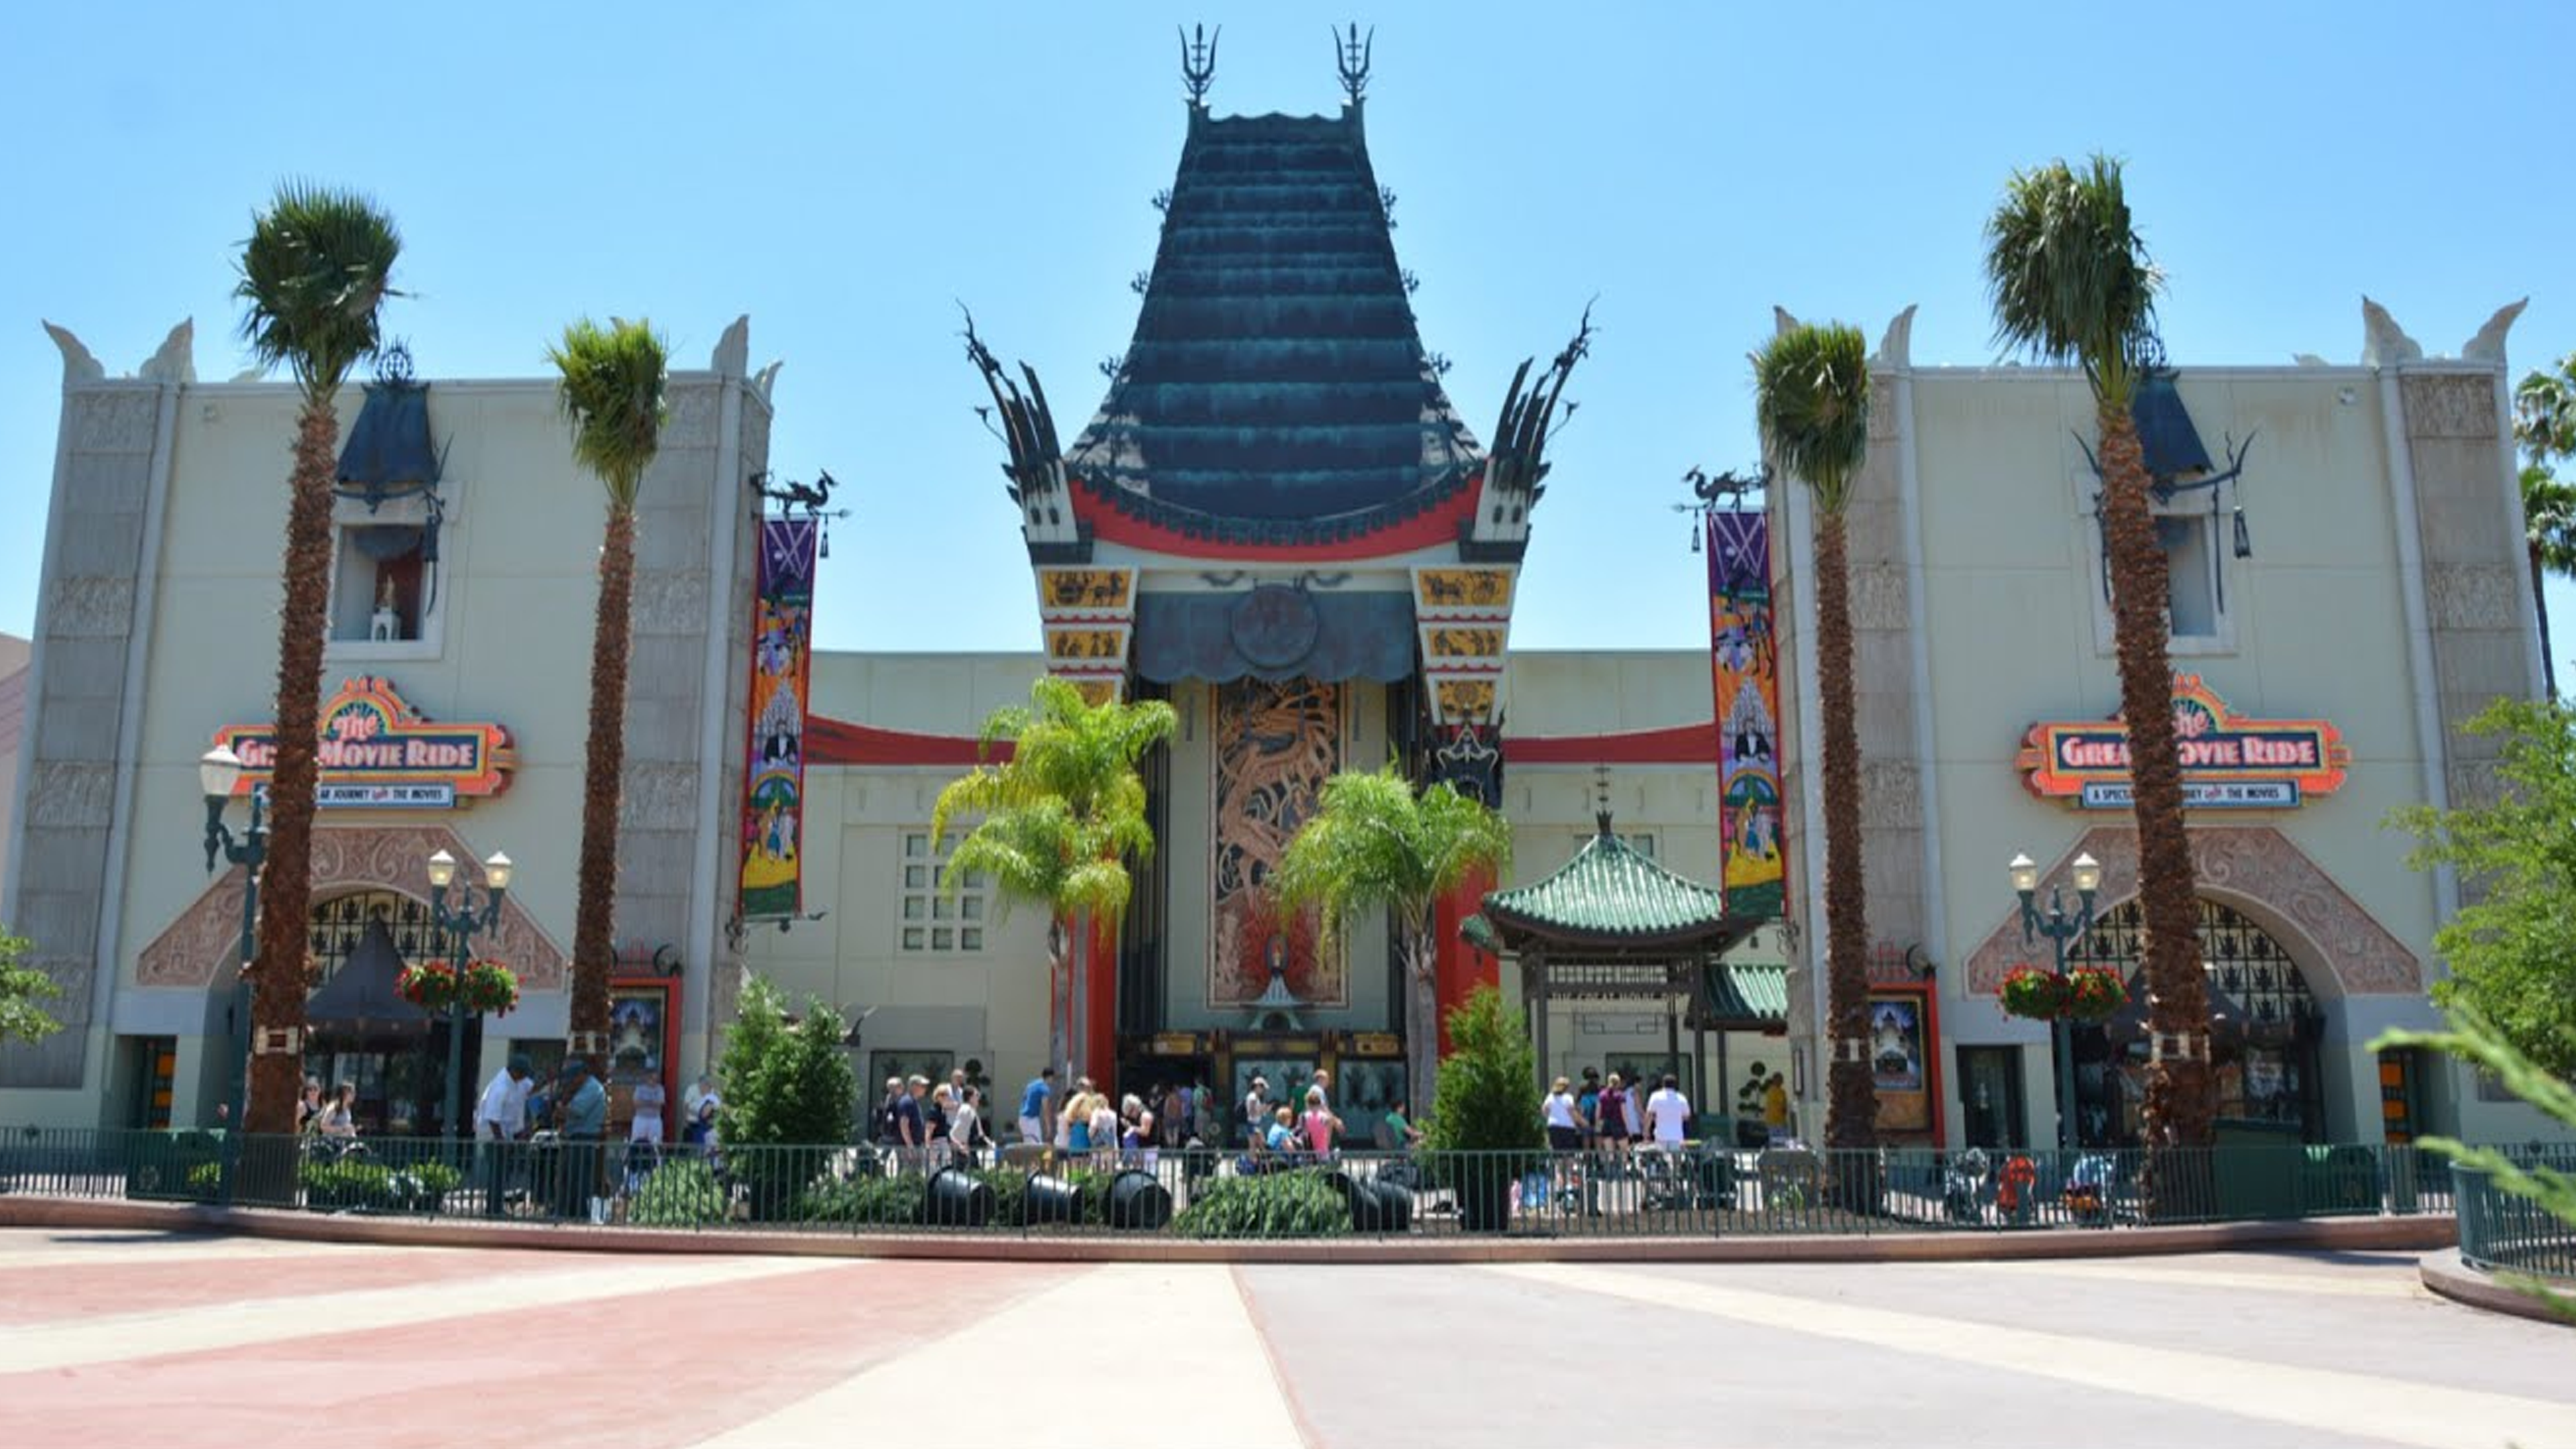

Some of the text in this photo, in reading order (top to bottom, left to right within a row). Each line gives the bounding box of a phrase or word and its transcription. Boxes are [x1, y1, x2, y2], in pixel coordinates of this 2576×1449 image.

[332, 710, 378, 740] The
[2171, 702, 2208, 738] he
[319, 739, 474, 767] MOVIE RIDE
[2061, 737, 2315, 766] GREA OVIE RIDE
[334, 789, 370, 800] JOURNEY
[393, 789, 407, 799] THE
[411, 789, 442, 800] MOVIES
[2226, 788, 2243, 799] THE
[2247, 788, 2279, 799] MOVIES
